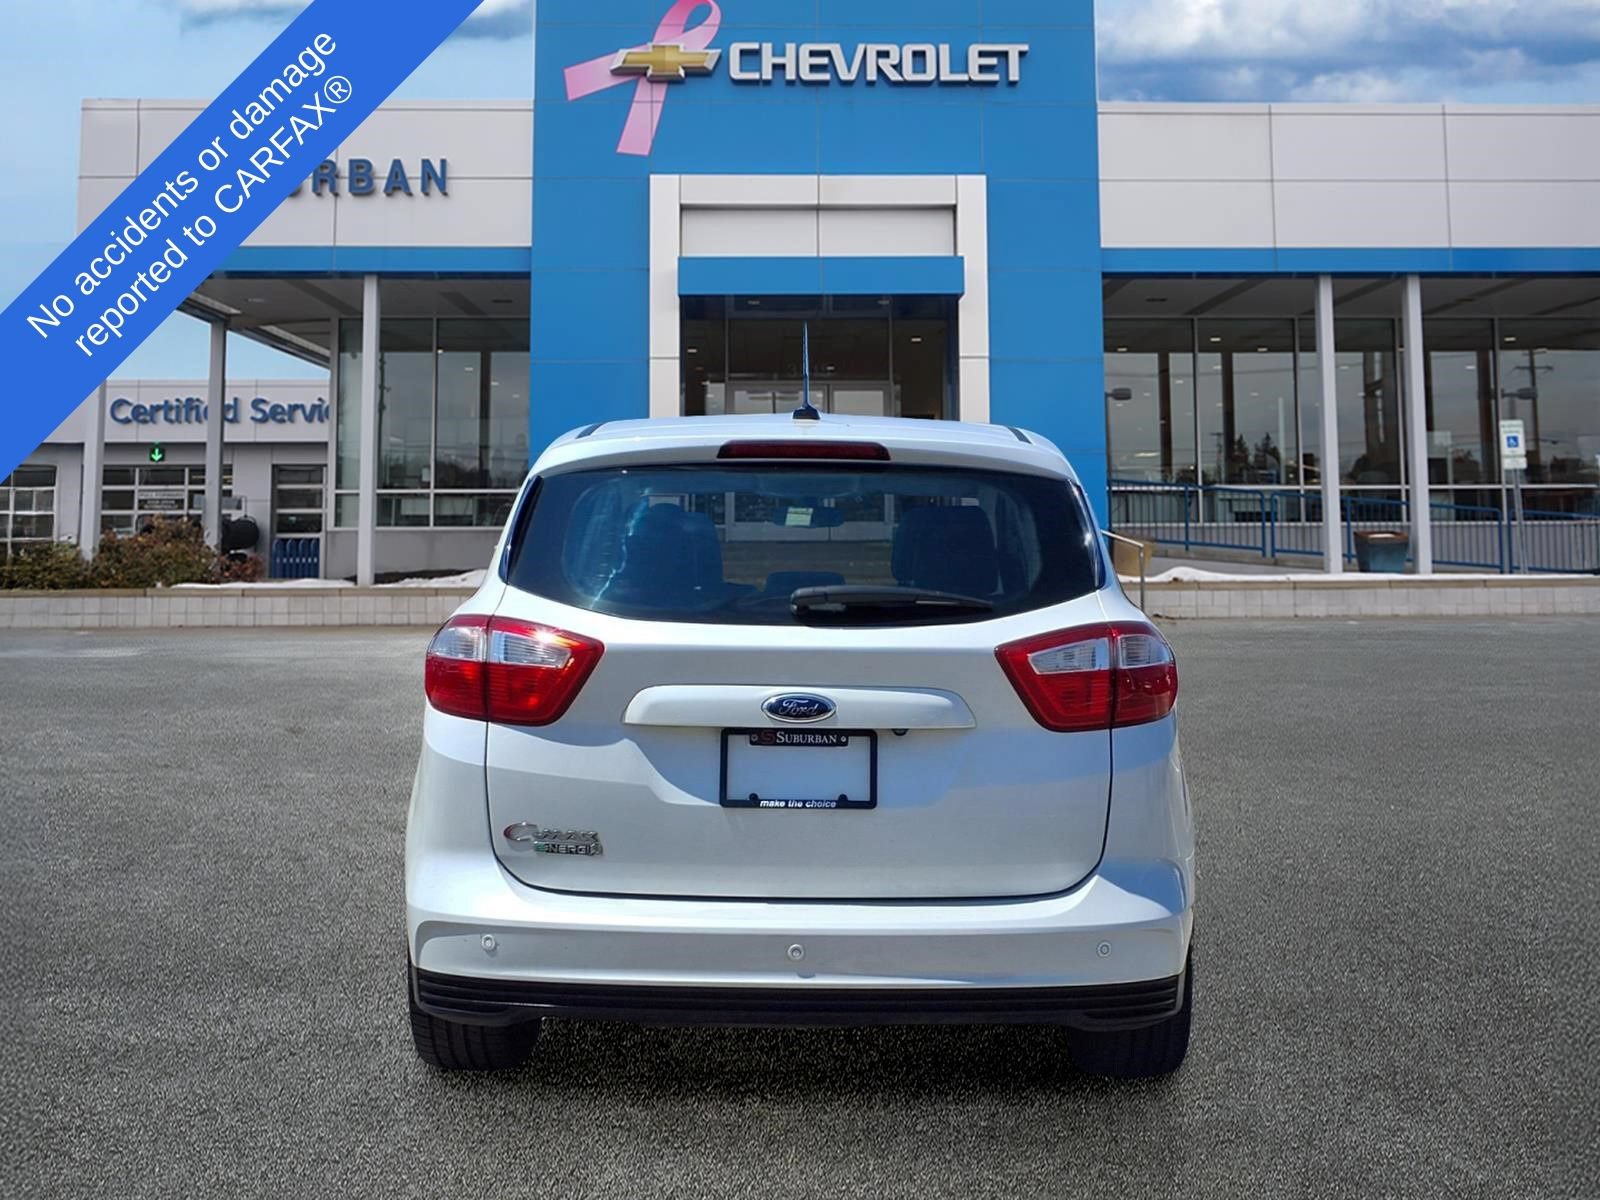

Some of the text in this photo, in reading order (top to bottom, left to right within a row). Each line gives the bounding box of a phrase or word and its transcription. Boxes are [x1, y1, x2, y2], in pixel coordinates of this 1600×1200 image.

[729, 42, 1029, 83] CHEVROLET
[289, 158, 448, 196] RBAN
[779, 699, 819, 716] Ford
[760, 800, 837, 808] make the choice
